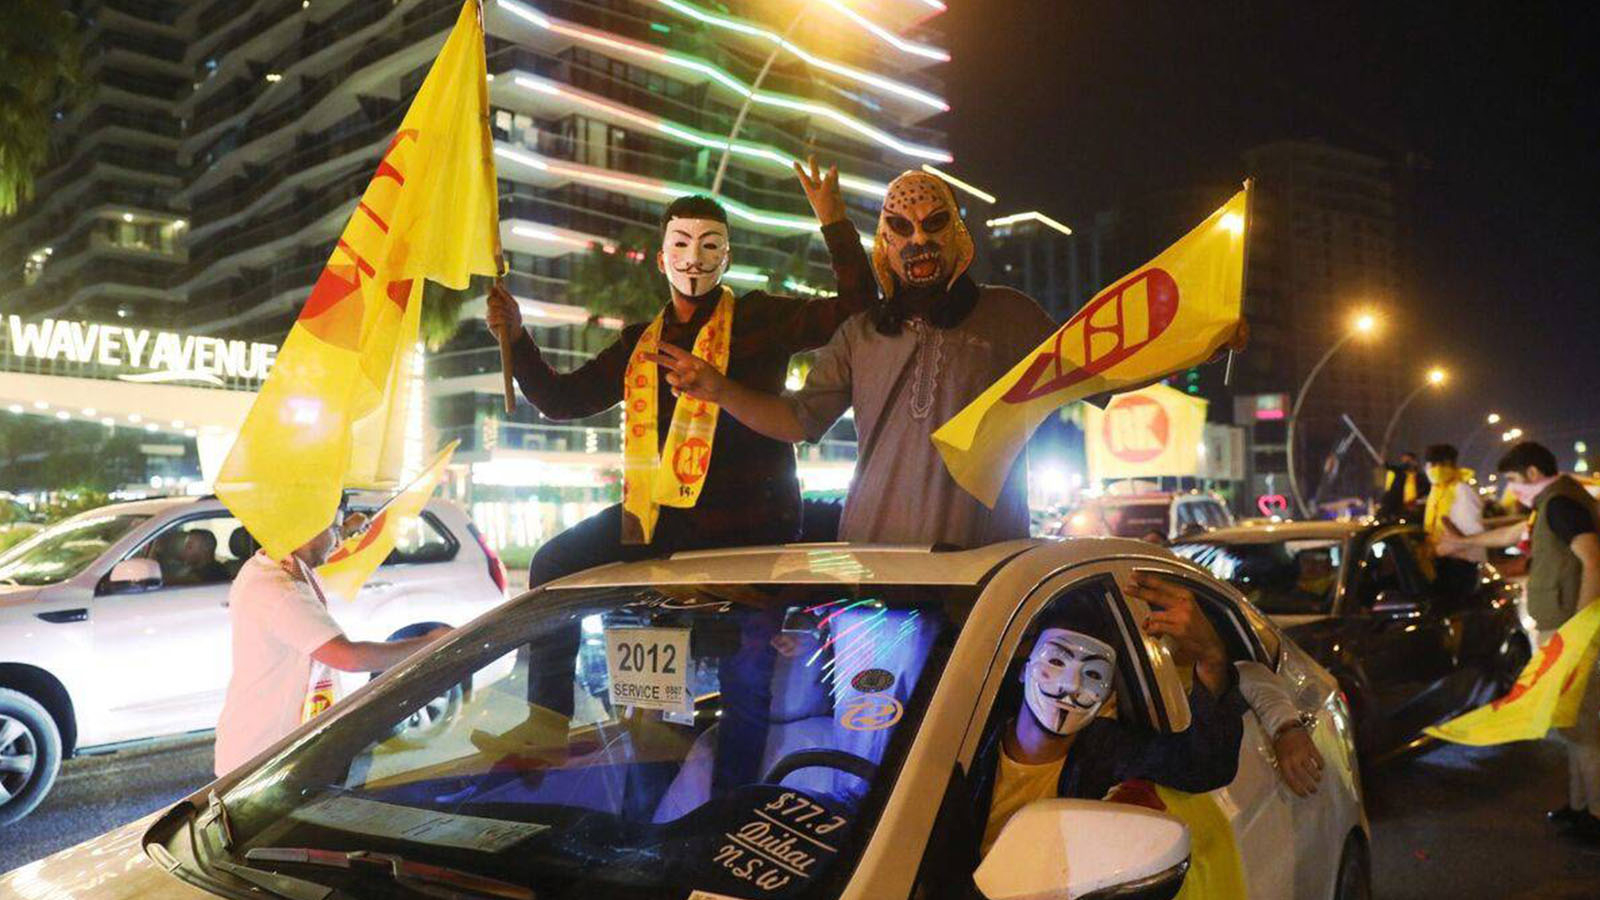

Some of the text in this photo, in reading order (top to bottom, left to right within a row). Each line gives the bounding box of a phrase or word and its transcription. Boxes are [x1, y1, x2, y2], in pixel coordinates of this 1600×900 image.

[9, 315, 278, 379] WAVEY AVENUE
[617, 642, 676, 674] 2012
[614, 683, 660, 699] SERVICE
